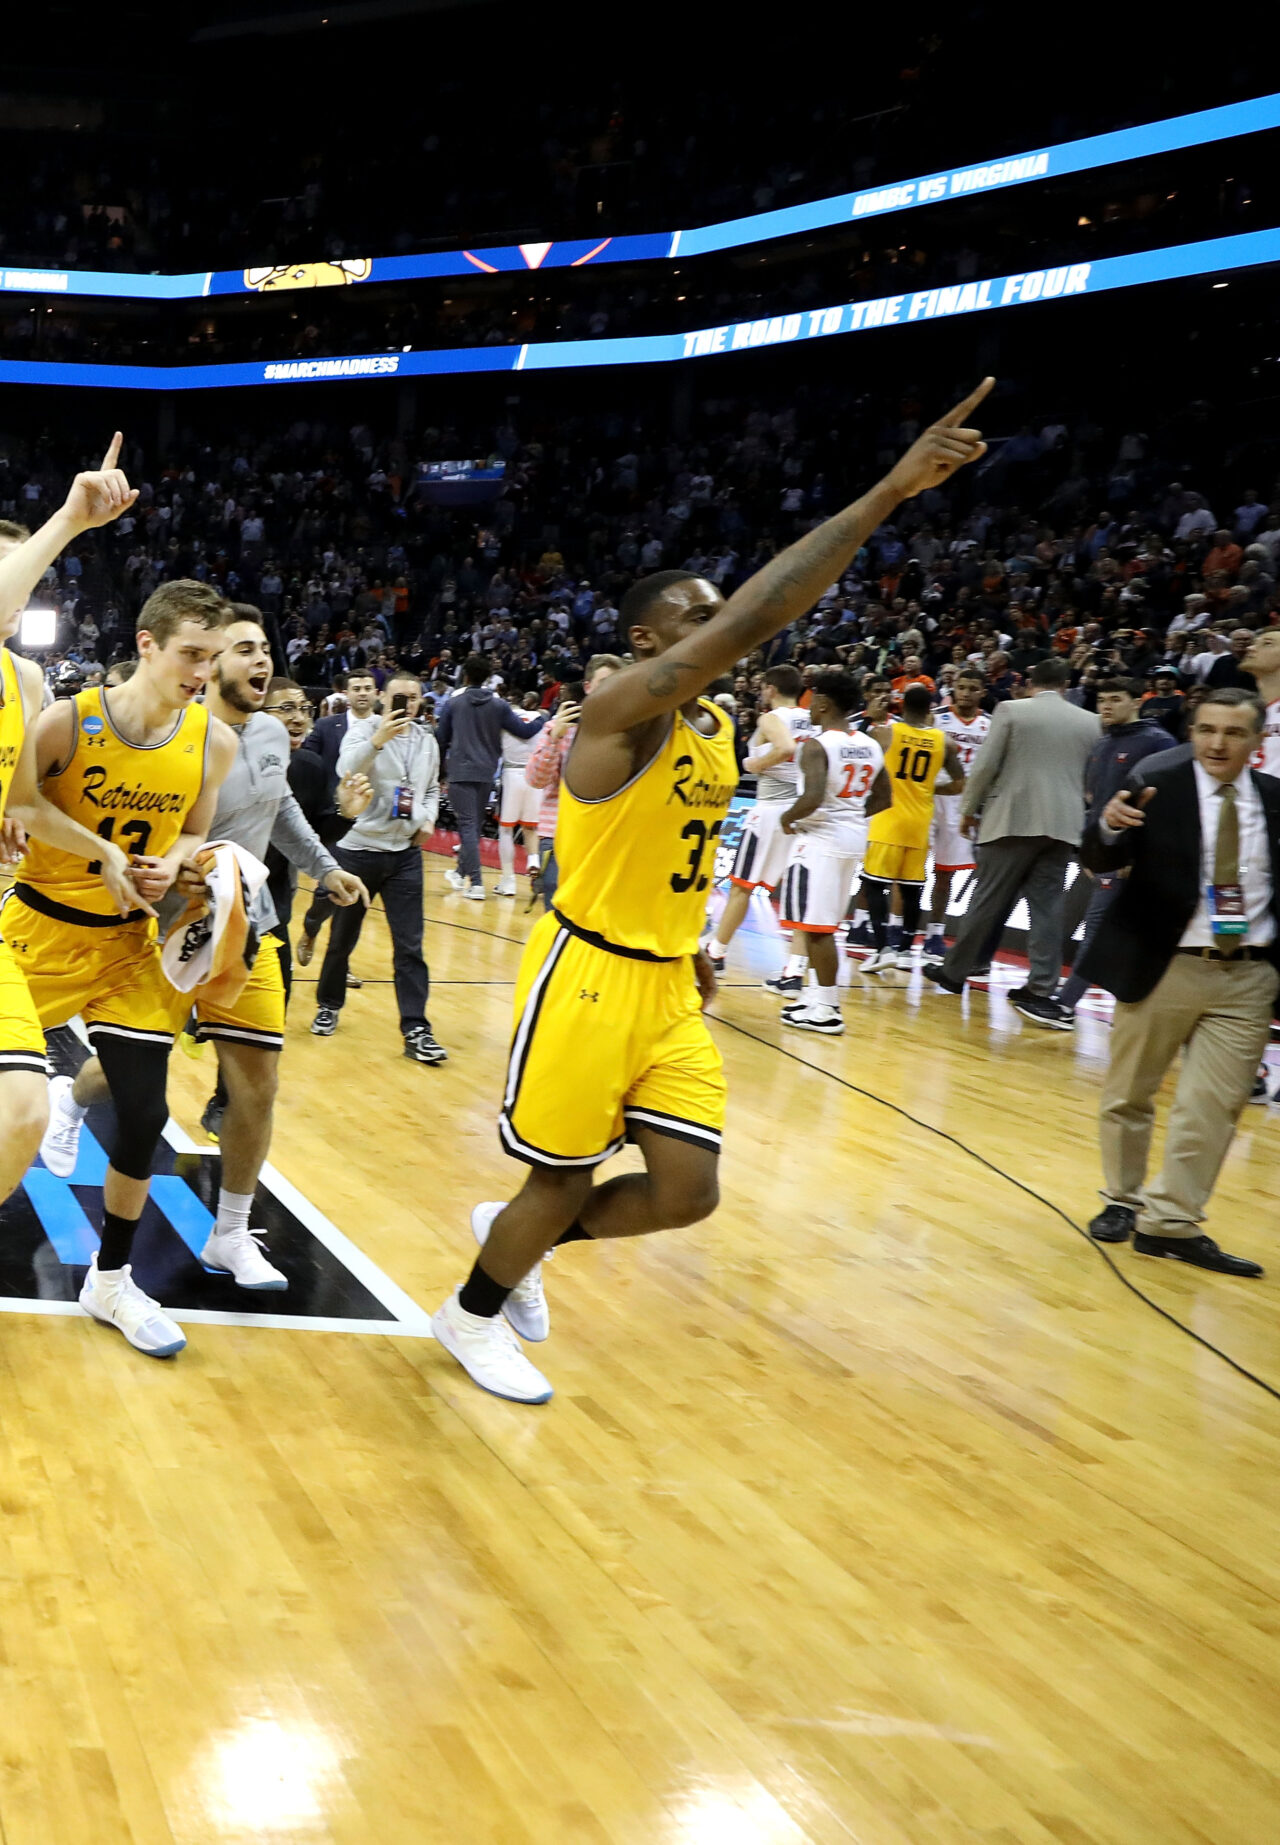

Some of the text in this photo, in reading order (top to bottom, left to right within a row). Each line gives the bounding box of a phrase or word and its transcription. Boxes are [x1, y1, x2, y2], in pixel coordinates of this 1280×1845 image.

[852, 152, 1049, 216] UMBC VS VIRGINIA
[683, 263, 1091, 357] THE ROAD TO THE FINAL FOUR
[264, 356, 399, 379] #MARCHMADNESS
[836, 763, 874, 798] 23
[895, 747, 931, 782] 10
[80, 765, 186, 813] Retrievers
